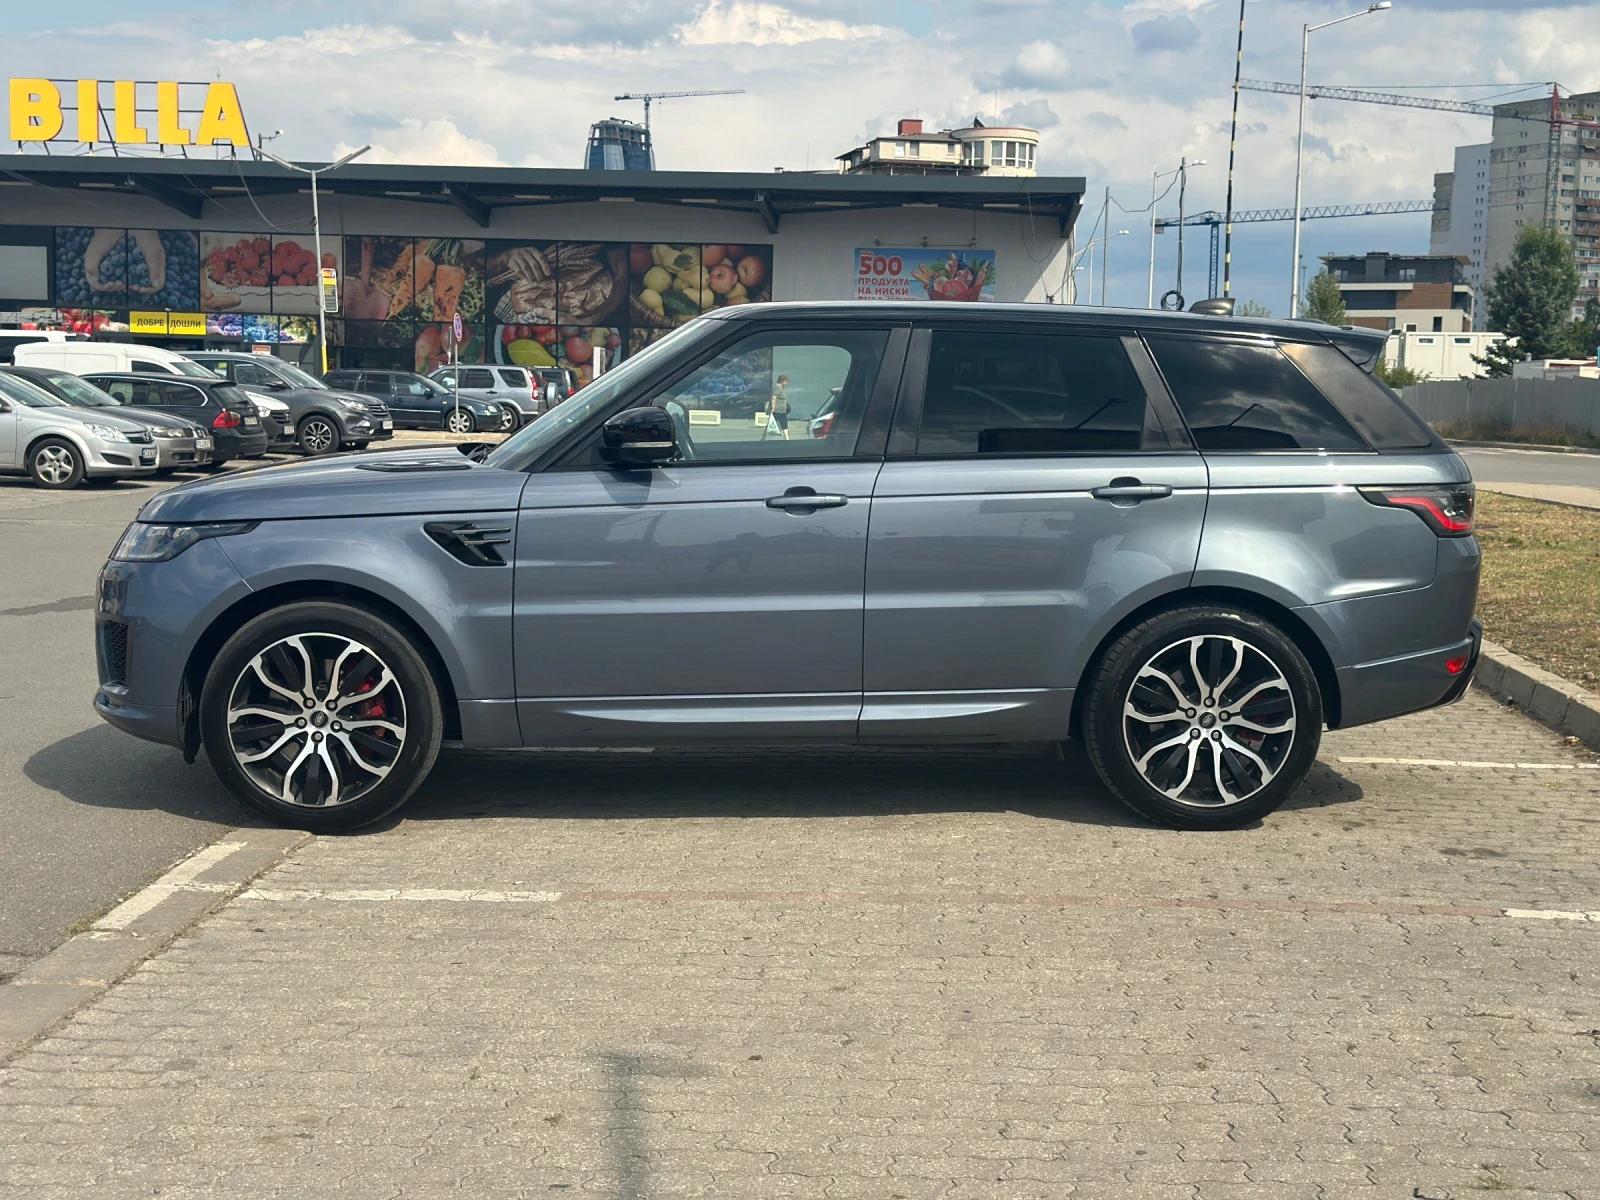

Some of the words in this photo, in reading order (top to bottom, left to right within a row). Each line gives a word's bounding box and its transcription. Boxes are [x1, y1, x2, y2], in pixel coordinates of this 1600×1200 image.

[9, 78, 250, 146] BILLA
[859, 255, 903, 276] 500
[858, 277, 910, 286] ПРОДУКТА
[858, 287, 871, 295] НА
[875, 287, 909, 295] НИСКИ
[137, 318, 164, 326] ДОБРЕ
[170, 319, 201, 328] ДОШЛИ
